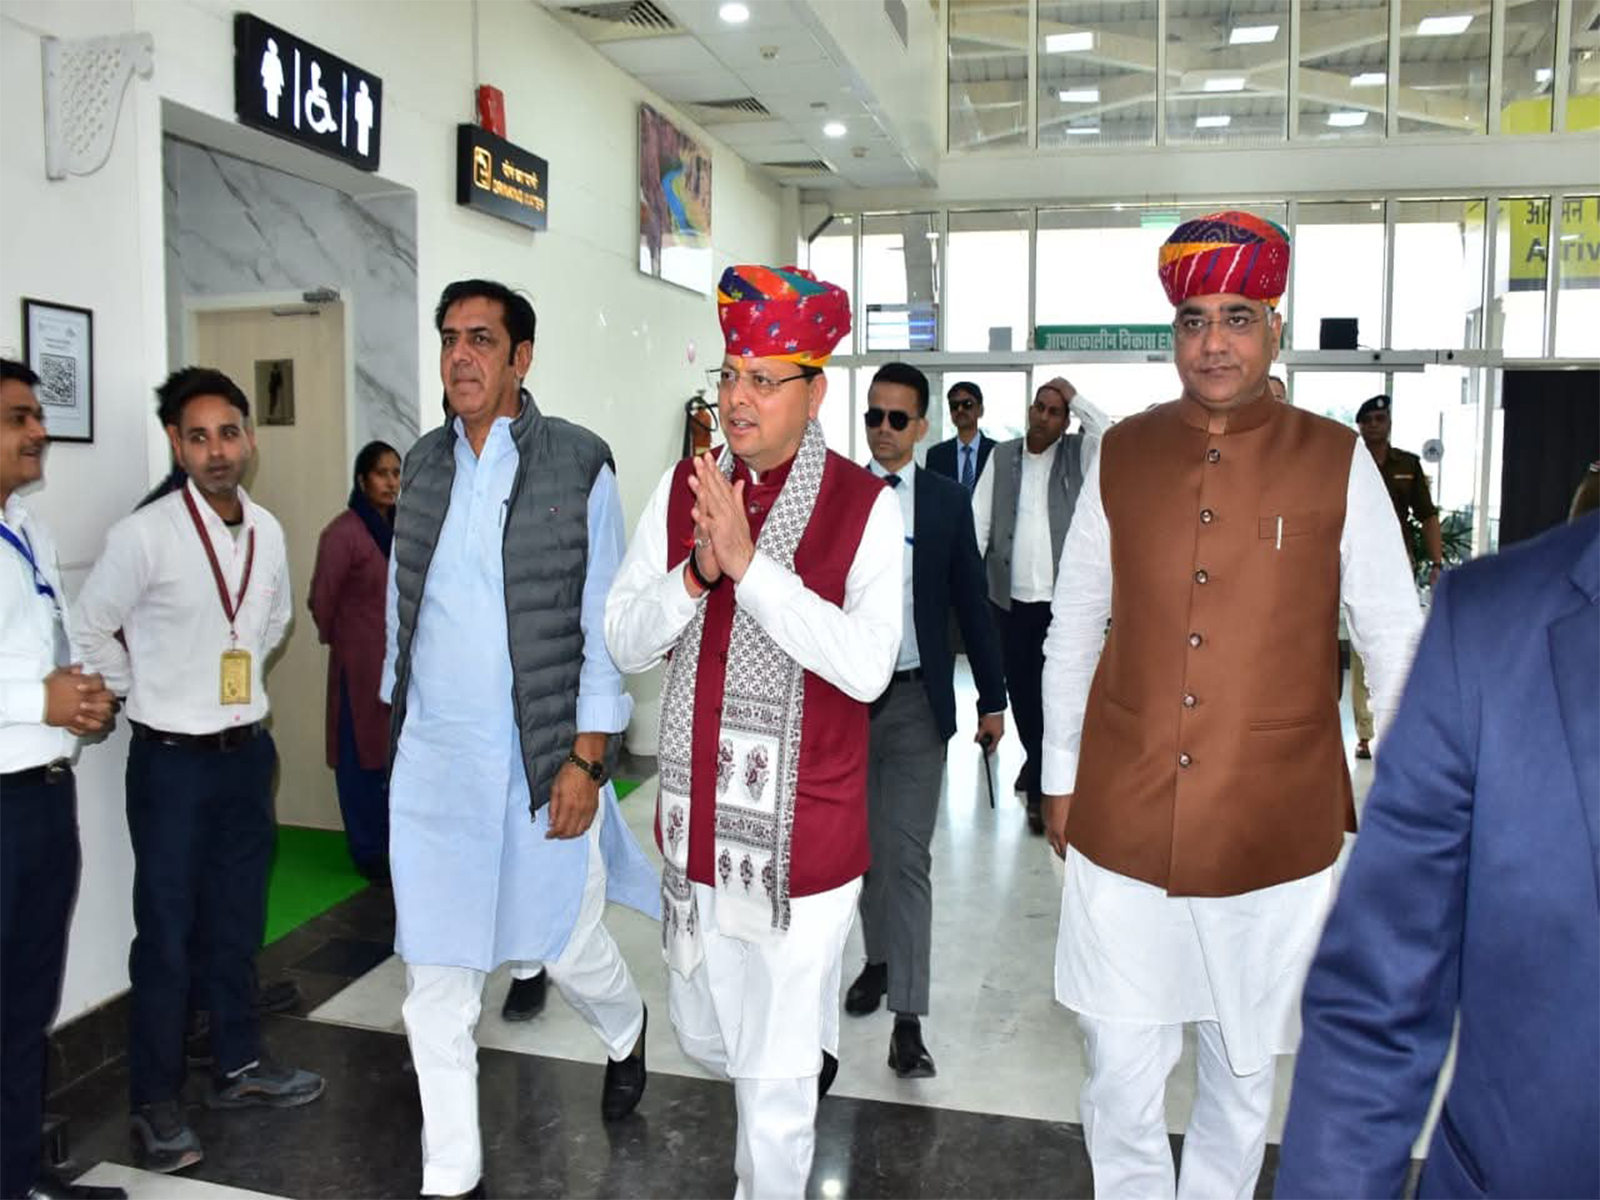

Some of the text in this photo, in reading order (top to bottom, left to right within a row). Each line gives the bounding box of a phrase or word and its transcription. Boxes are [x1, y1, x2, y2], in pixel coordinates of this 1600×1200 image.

[1526, 237, 1600, 262] Ariv
[1045, 328, 1117, 349] आपातकालीन
[1119, 328, 1156, 349] निकास
